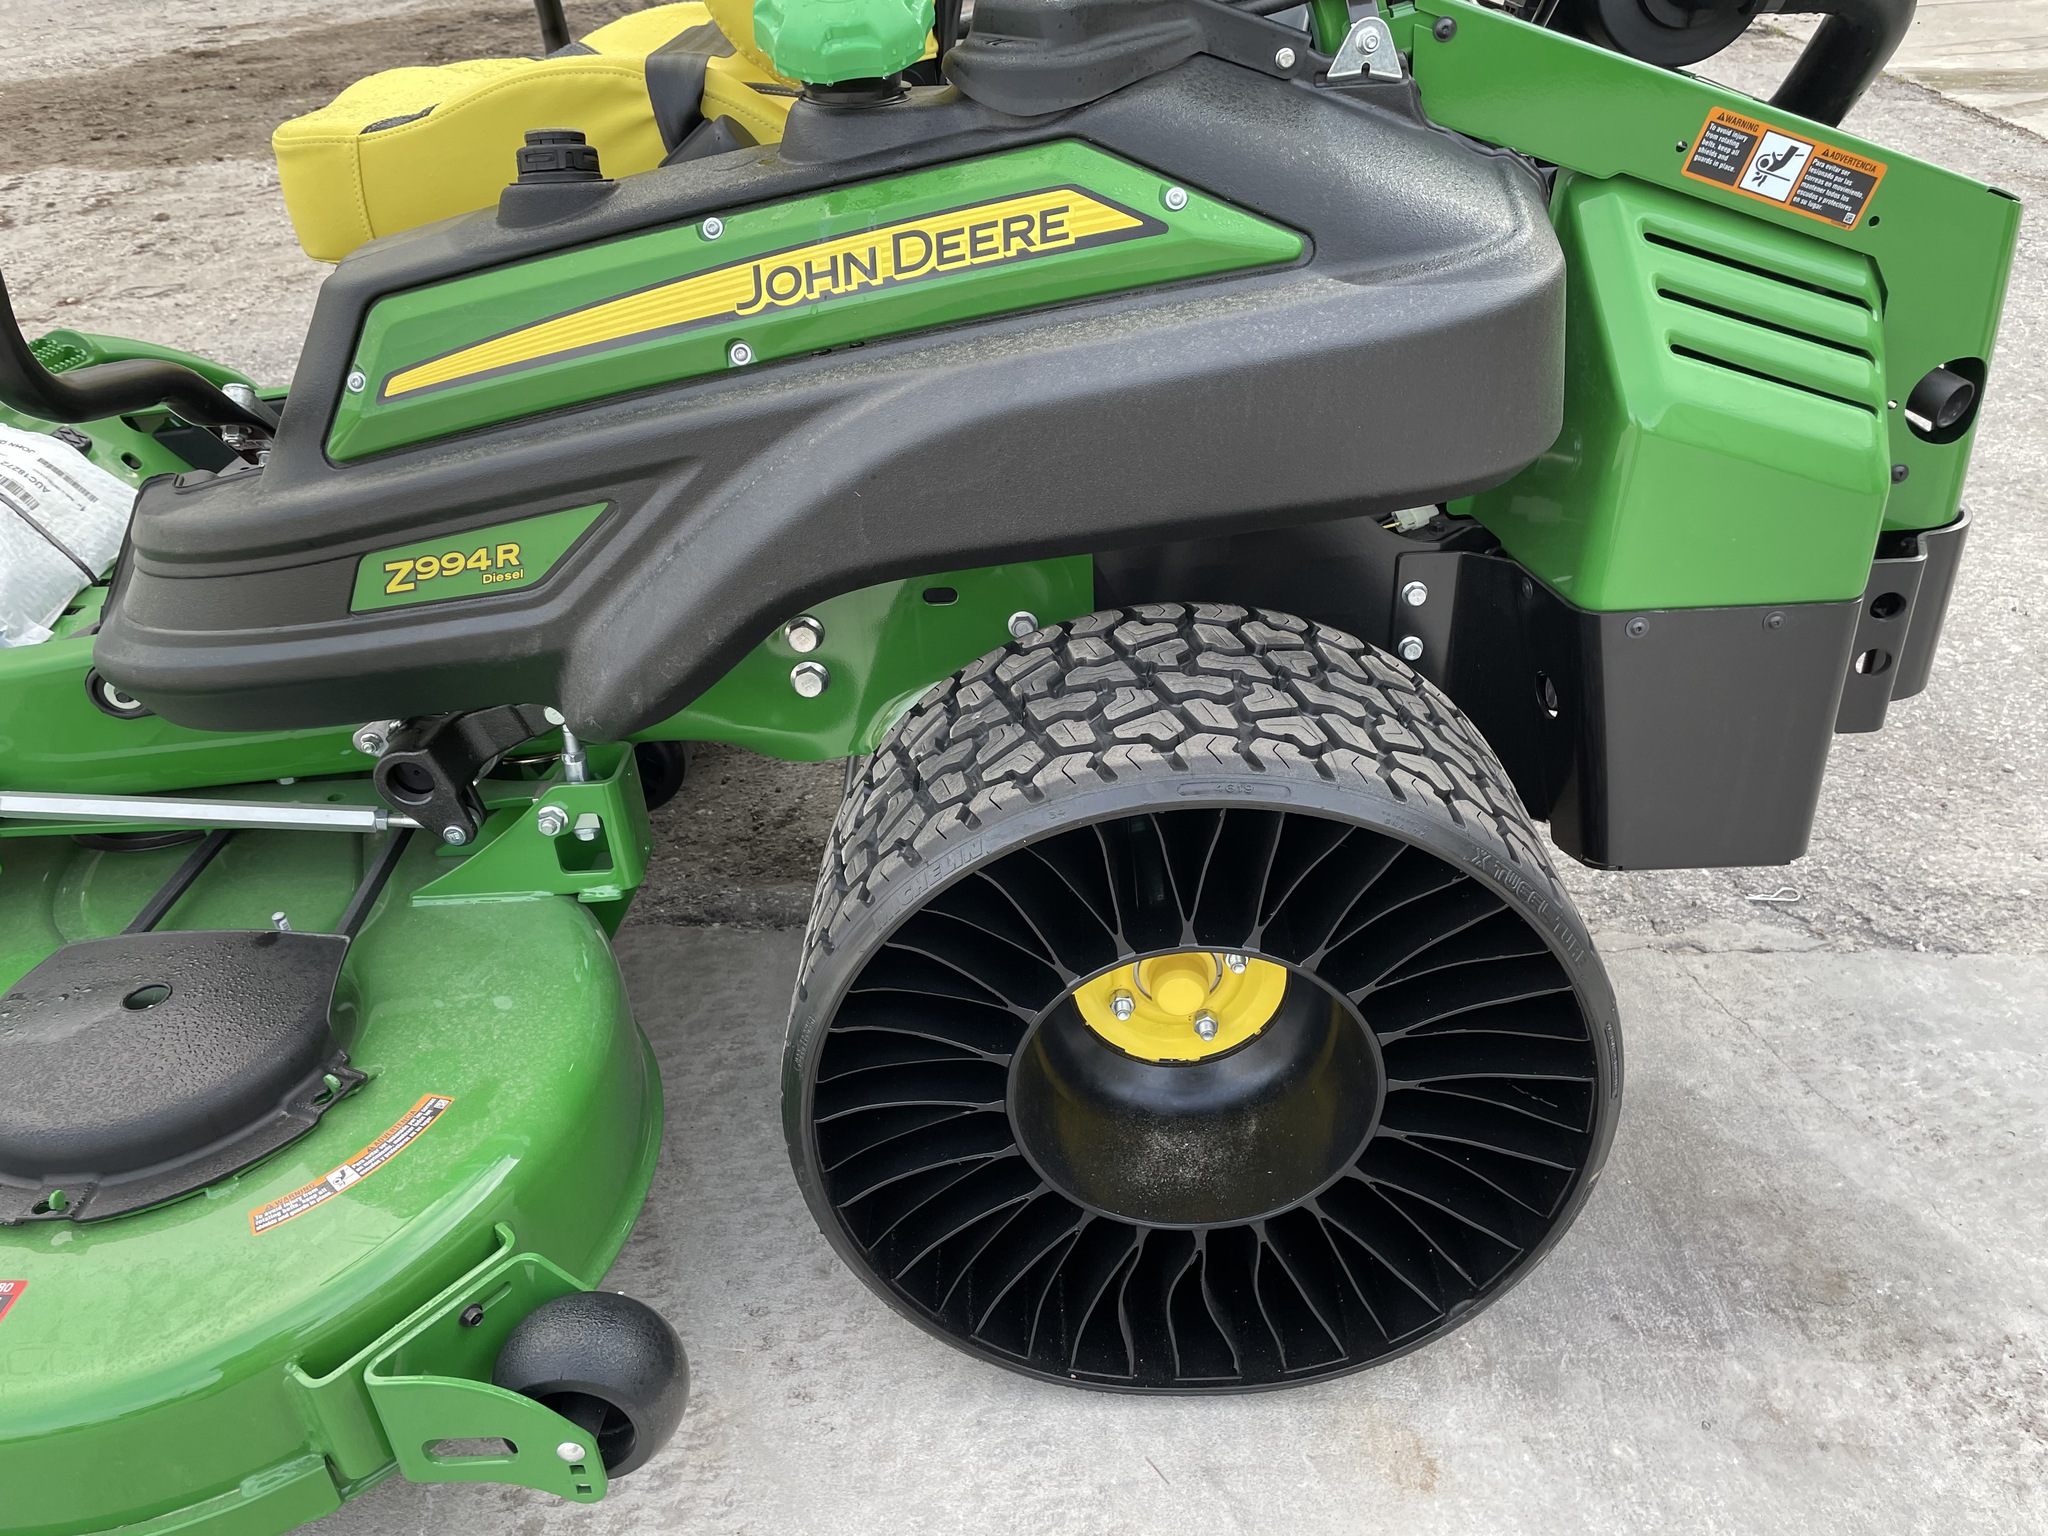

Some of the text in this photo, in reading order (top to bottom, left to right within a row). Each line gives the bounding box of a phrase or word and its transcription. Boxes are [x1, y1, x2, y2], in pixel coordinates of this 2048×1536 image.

[1710, 122, 1748, 143] To avoid injury
[1725, 114, 1759, 133] WARNING
[1704, 130, 1740, 149] from rotating
[1717, 144, 1732, 154] keep
[1694, 154, 1712, 165] guards
[1718, 162, 1736, 173] place.
[1698, 146, 1730, 162] shields and
[1830, 152, 1876, 173] ADVERTENCIA
[1812, 158, 1826, 168] Para
[1825, 164, 1840, 173] evitar
[1804, 174, 1824, 186] correas
[1808, 166, 1853, 186] lesionado por las
[1796, 189, 1818, 200] escudos
[1822, 196, 1852, 212] protectores
[1800, 181, 1850, 202] mantener todos los
[1807, 200, 1822, 210] lugar.
[736, 205, 1073, 313] JOHN DEERE
[8, 442, 36, 454] JOHN
[482, 568, 524, 585] Diesel
[1471, 846, 1492, 870] X
[374, 1110, 416, 1146] ADVERTENCIA
[264, 1205, 282, 1217] avoid
[282, 1196, 302, 1208] injury
[302, 1187, 319, 1198] from
[274, 1182, 316, 1206] WARNING
[255, 1210, 282, 1226] rotating
[300, 1193, 318, 1204] keep
[317, 1187, 327, 1195] all
[278, 1212, 290, 1222] and
